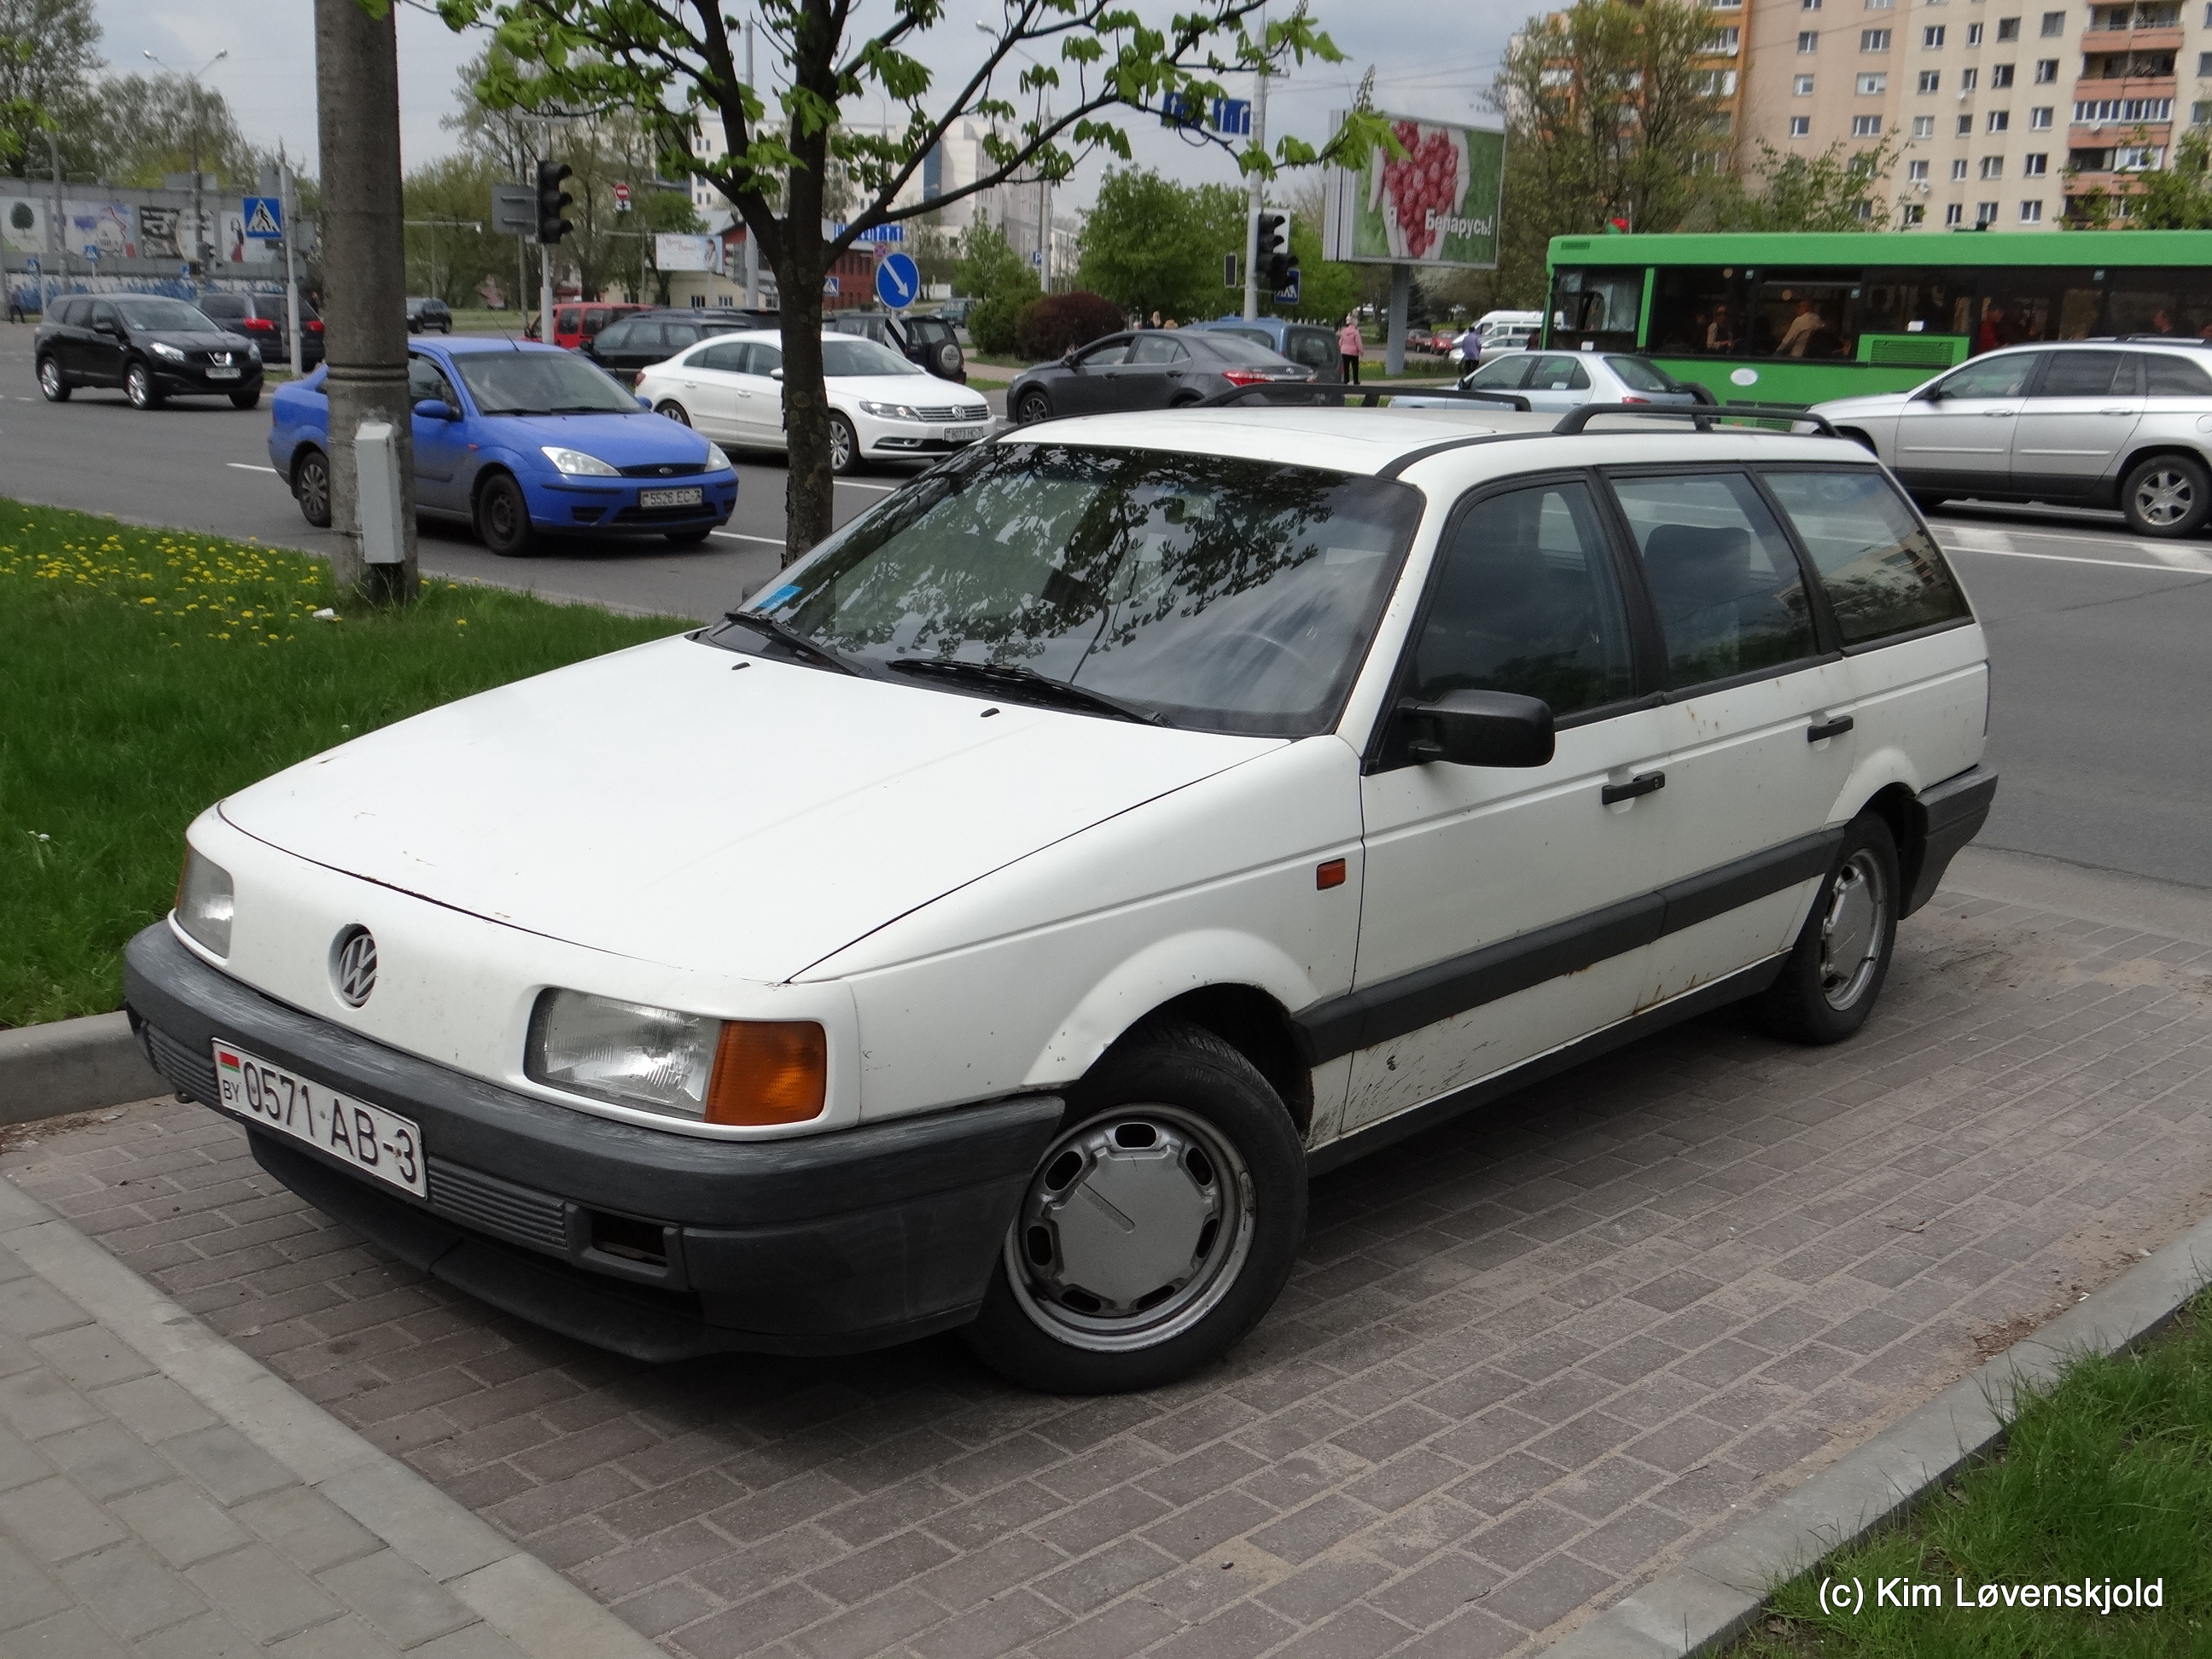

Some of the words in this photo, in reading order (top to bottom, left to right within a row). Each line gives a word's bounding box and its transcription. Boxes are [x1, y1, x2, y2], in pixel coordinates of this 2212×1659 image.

[1388, 206, 1398, 229] Я
[1425, 207, 1493, 240] Беларусь!
[650, 492, 673, 505] 5526
[677, 489, 701, 504] EC-7
[222, 1079, 241, 1108] BY
[243, 1061, 315, 1137] 0571
[330, 1098, 417, 1185] AB-3
